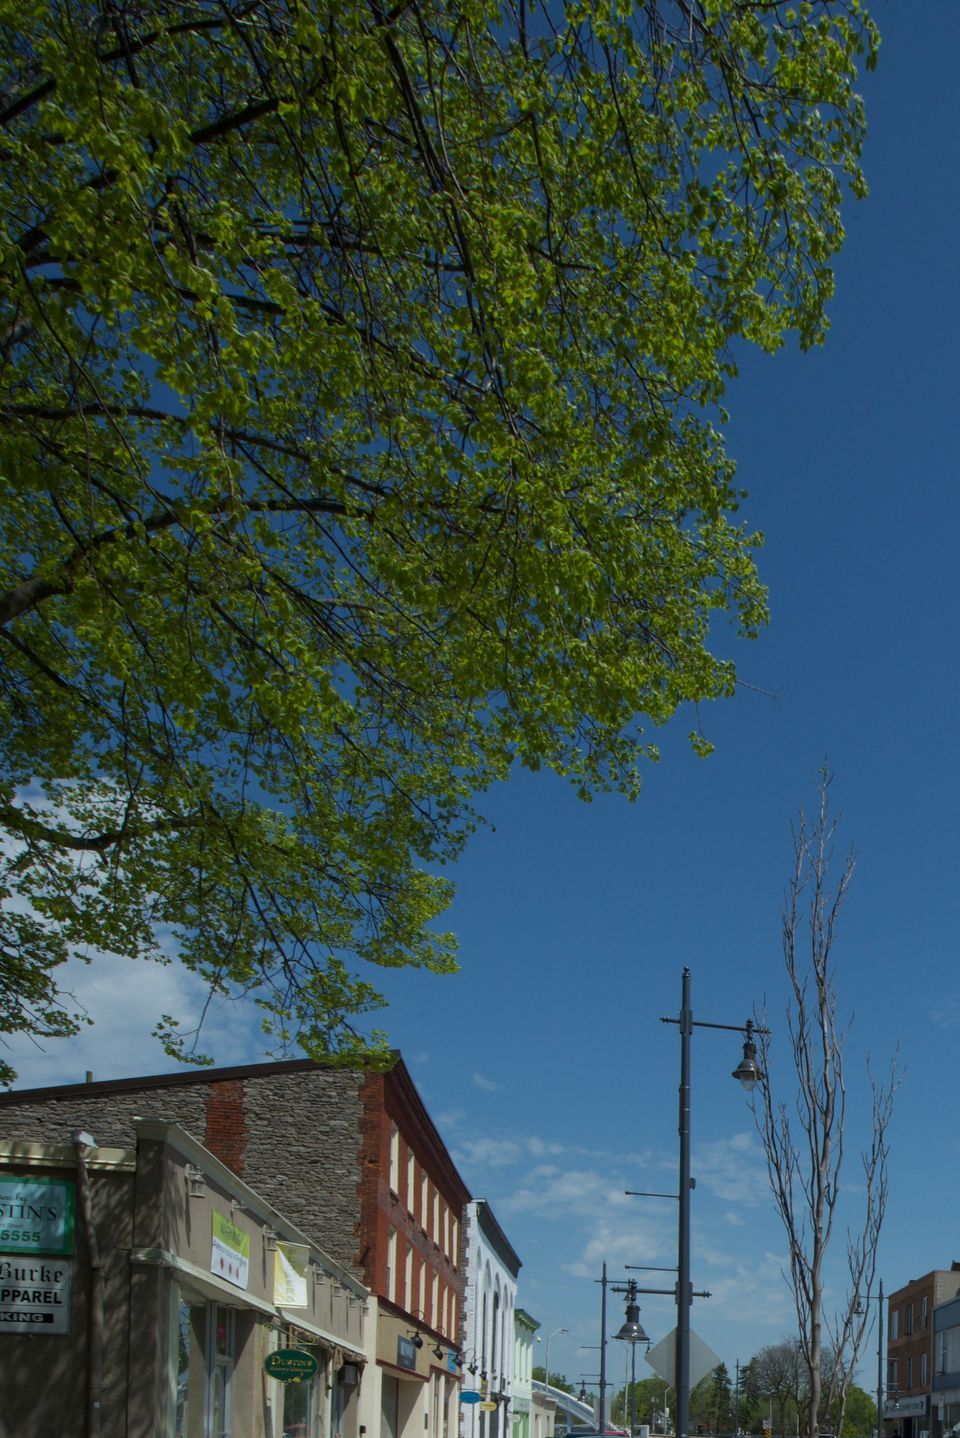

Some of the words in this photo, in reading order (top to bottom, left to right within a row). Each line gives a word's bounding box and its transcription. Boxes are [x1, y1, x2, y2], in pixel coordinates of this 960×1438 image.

[0, 1262, 63, 1283] Burke
[1, 1289, 62, 1304] PPAREL
[0, 1313, 44, 1322] KING
